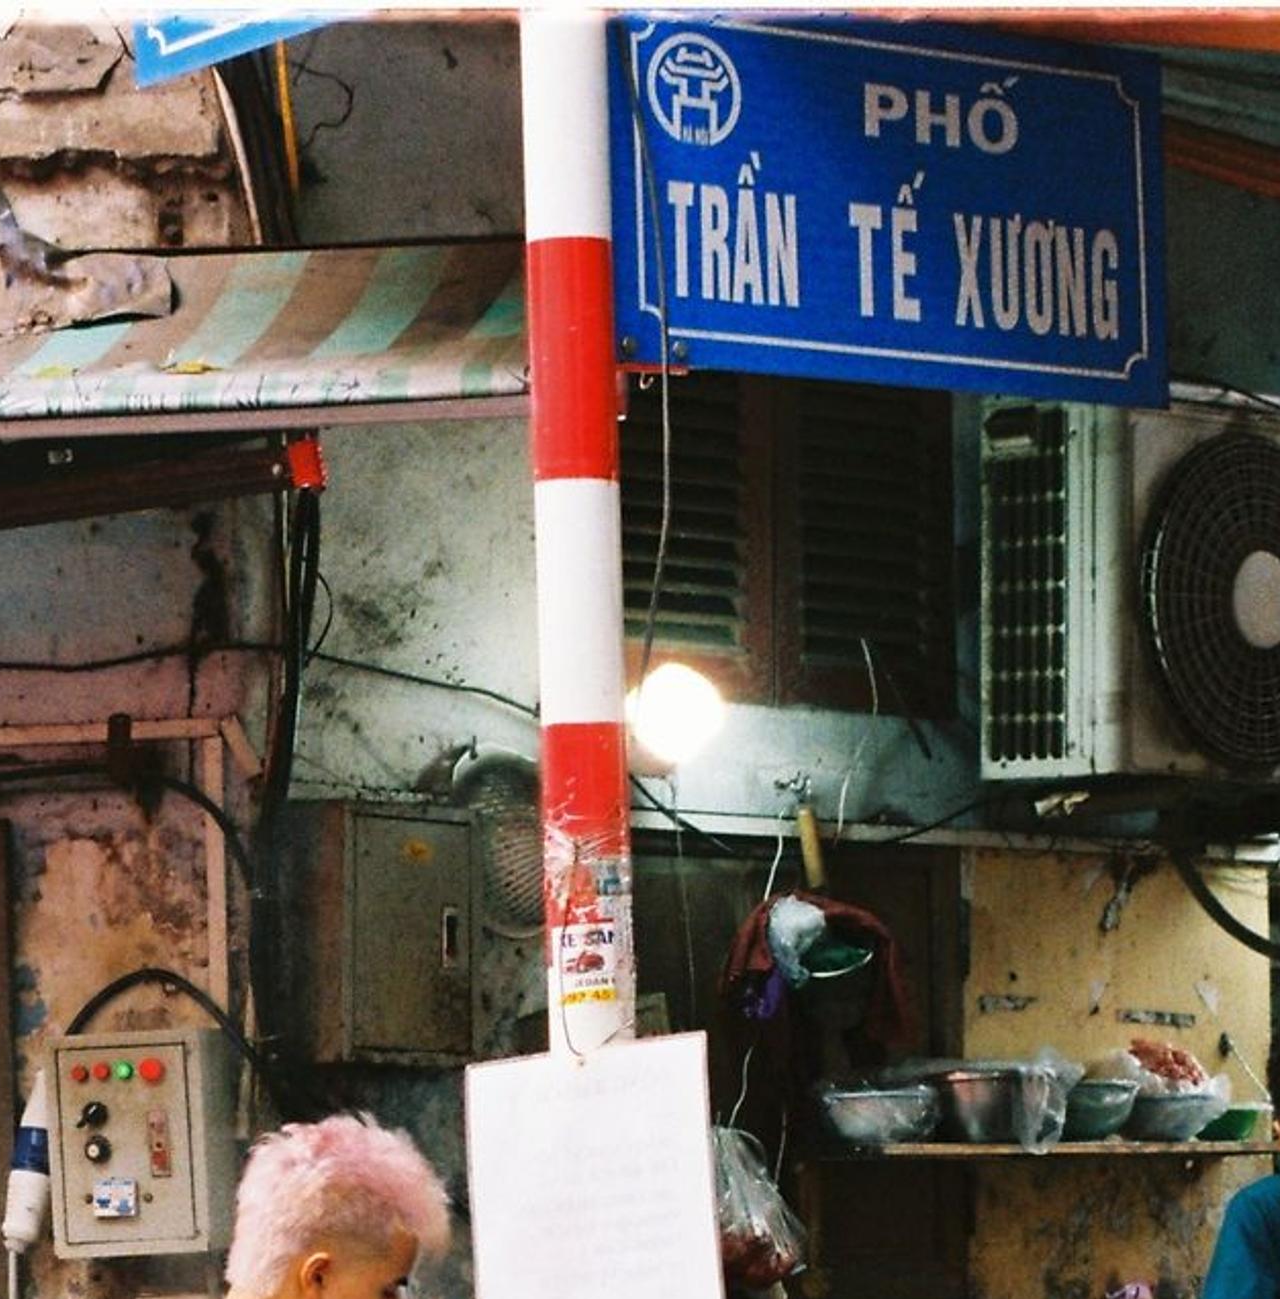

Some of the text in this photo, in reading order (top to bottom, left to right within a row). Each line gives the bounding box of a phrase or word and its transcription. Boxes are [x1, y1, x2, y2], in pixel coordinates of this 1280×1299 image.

[864, 75, 1019, 155] PHỐ
[667, 152, 1120, 341] TRẦN TẾ XƯƠNG
